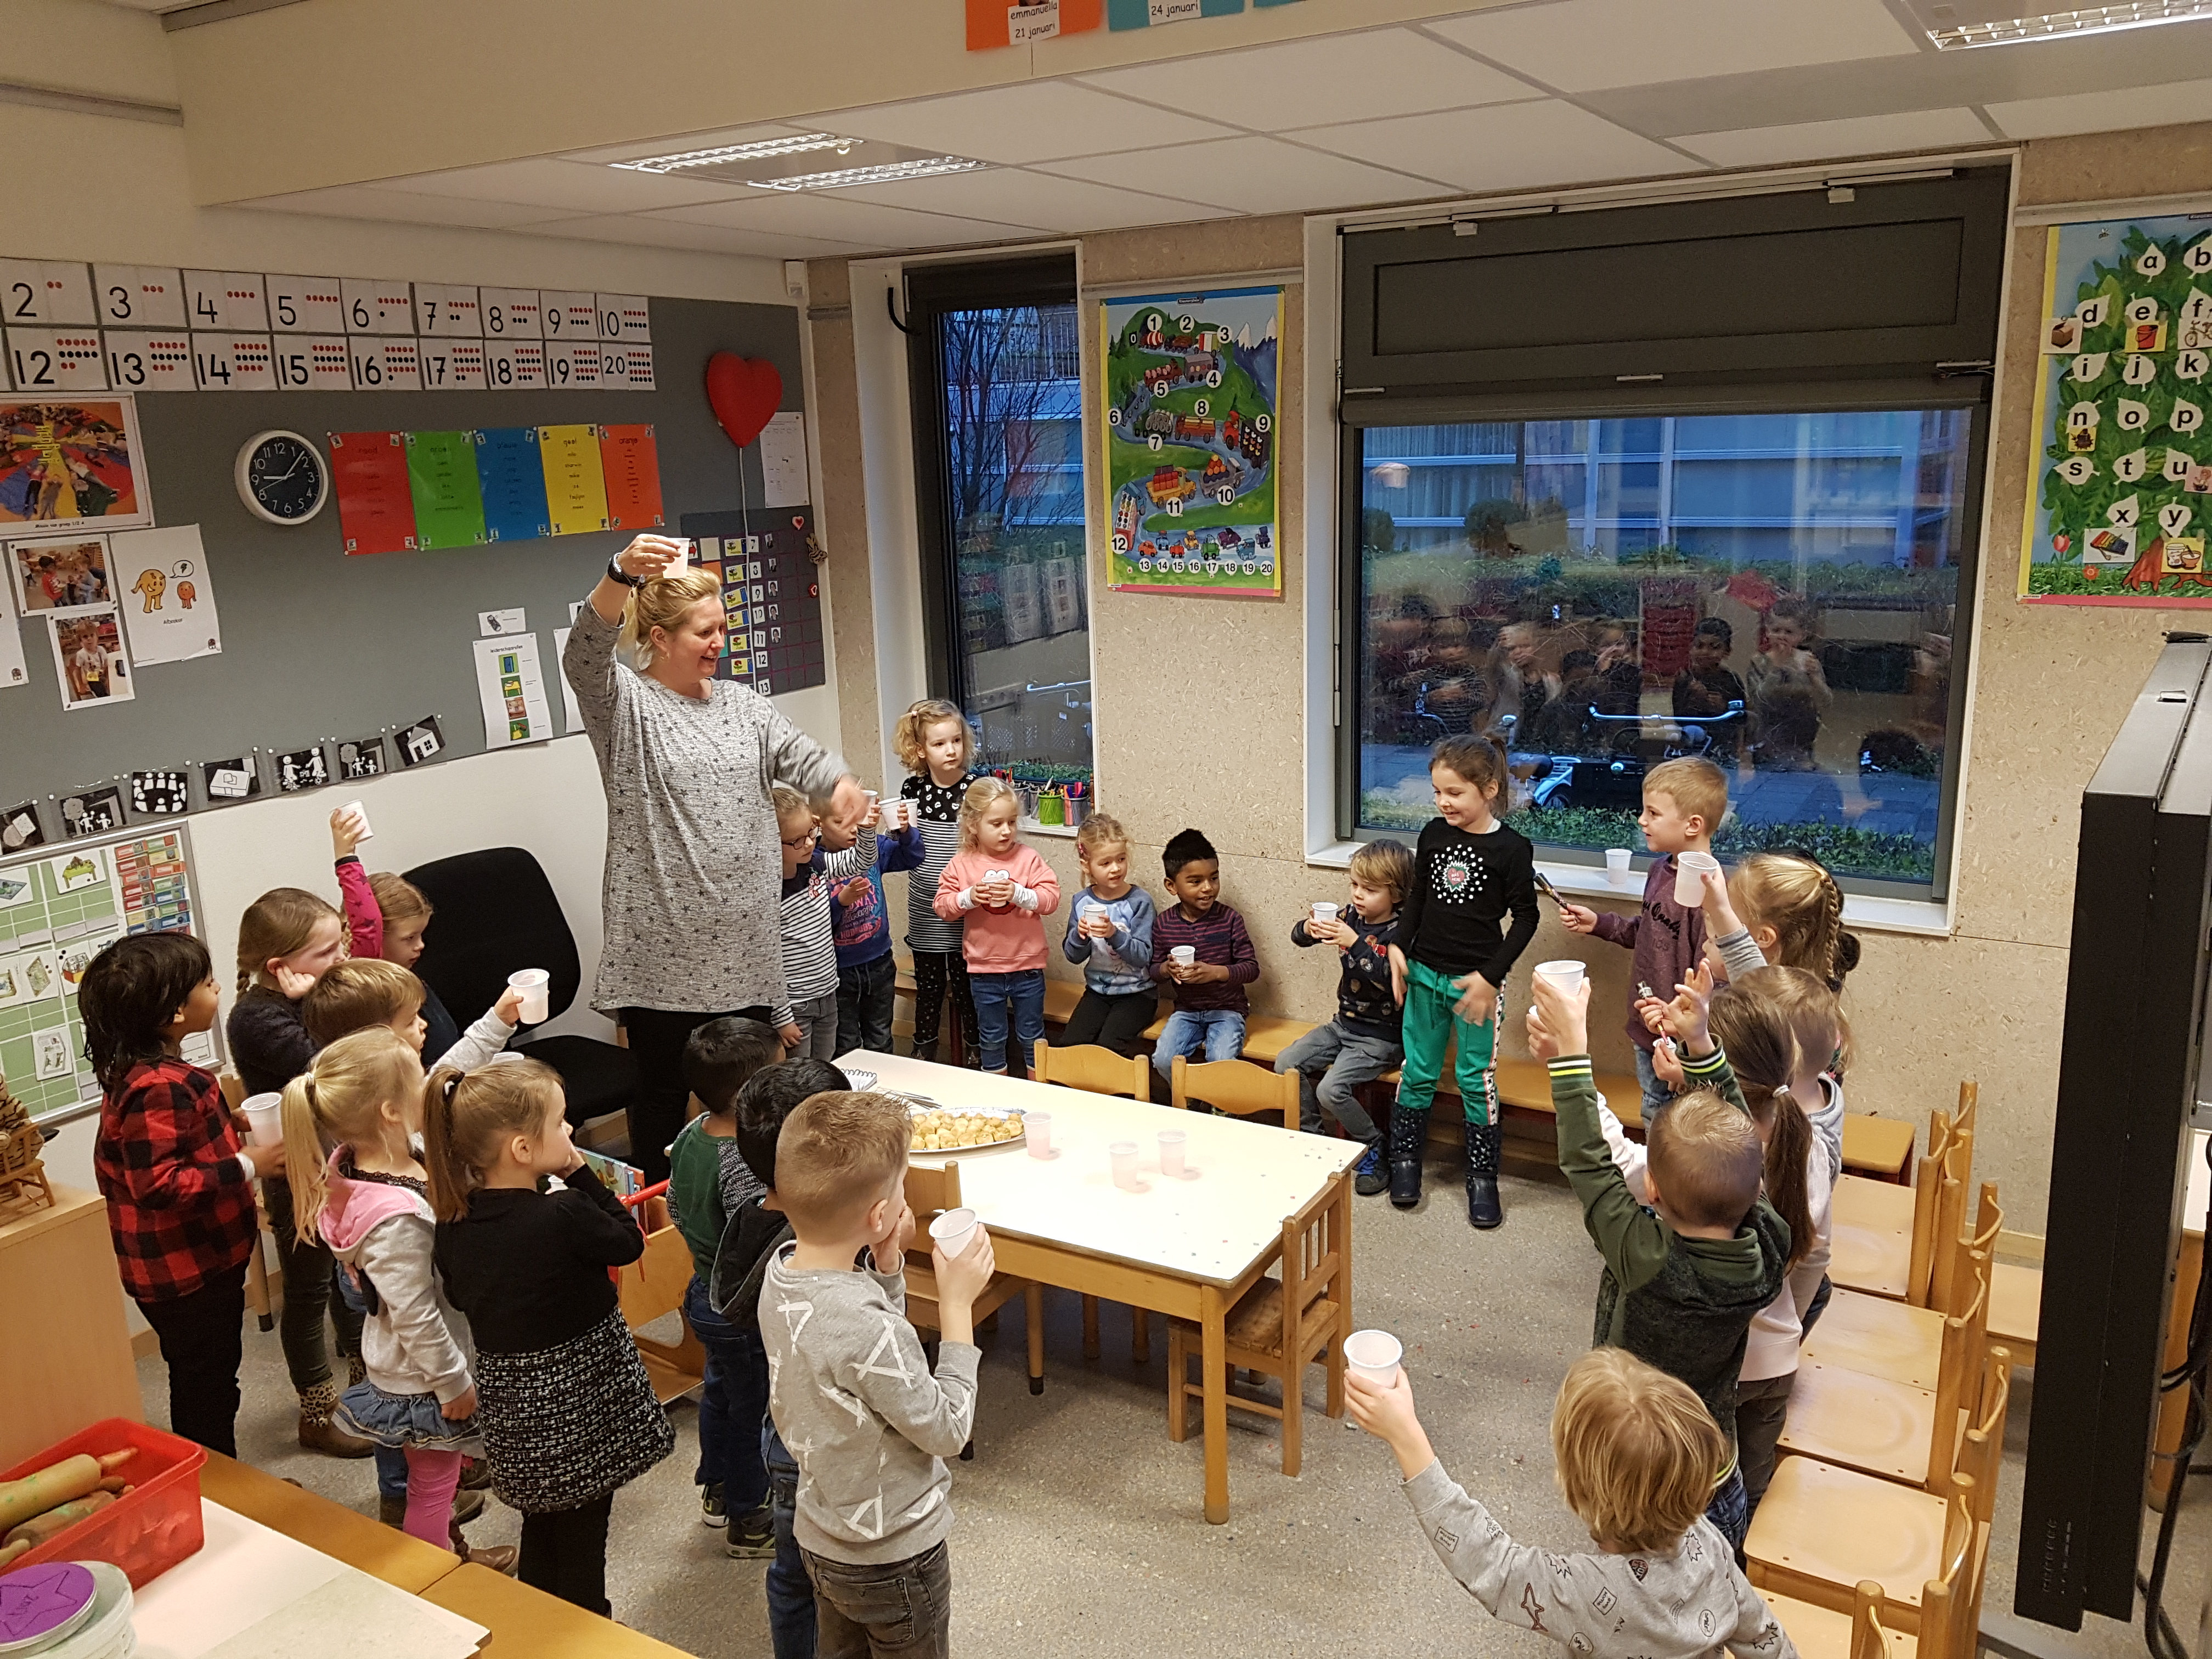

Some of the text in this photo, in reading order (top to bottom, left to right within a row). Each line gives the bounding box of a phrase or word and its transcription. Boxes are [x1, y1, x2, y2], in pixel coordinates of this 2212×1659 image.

[1011, 2, 1057, 19] emmanuella
[1152, 1, 1199, 16] 24 januari
[1015, 23, 1054, 39] 21 januari
[2144, 245, 2211, 268] a b
[13, 283, 619, 336] 2 3 4 5 6 7 8 9 10
[2083, 298, 2203, 324] d e f
[1150, 317, 1158, 331] 1
[1183, 317, 1190, 330] 2
[1131, 334, 1136, 343] 0
[1221, 327, 1229, 341] 3
[15, 351, 625, 385] 12 13 14 15 16 17 18 19 20
[2083, 354, 2199, 377] i j k
[1209, 372, 1217, 386] 4
[1157, 382, 1165, 396] 5
[1198, 401, 1206, 414] 8
[1110, 410, 1118, 424] 6
[1260, 416, 1267, 430] 9
[2073, 408, 2193, 427] n o p
[274, 443, 285, 454] 12
[1152, 437, 1159, 449] 7
[263, 447, 270, 458] 11
[291, 447, 295, 456] 1
[253, 459, 266, 469] 10
[302, 456, 309, 467] 2
[2069, 459, 2187, 476] s t u
[251, 475, 259, 485] 9
[308, 472, 314, 482] 3
[259, 489, 267, 500] 8
[306, 488, 312, 498] 4
[1218, 489, 1233, 502] 10
[273, 500, 277, 511] 7
[284, 503, 291, 513] 6
[298, 498, 304, 509] 5
[1168, 500, 1180, 513] 11
[2115, 510, 2183, 527] x y
[751, 539, 755, 549] 7
[1111, 538, 1125, 550] 12
[753, 565, 758, 575] 8
[1190, 562, 1199, 571] 16
[1207, 563, 1216, 571] 17
[1226, 563, 1235, 572] 18
[1262, 564, 1272, 572] 20
[755, 589, 760, 599] 9
[755, 610, 762, 619] 10
[757, 634, 763, 644] 11
[758, 654, 766, 664] 12
[760, 683, 769, 693] 13
